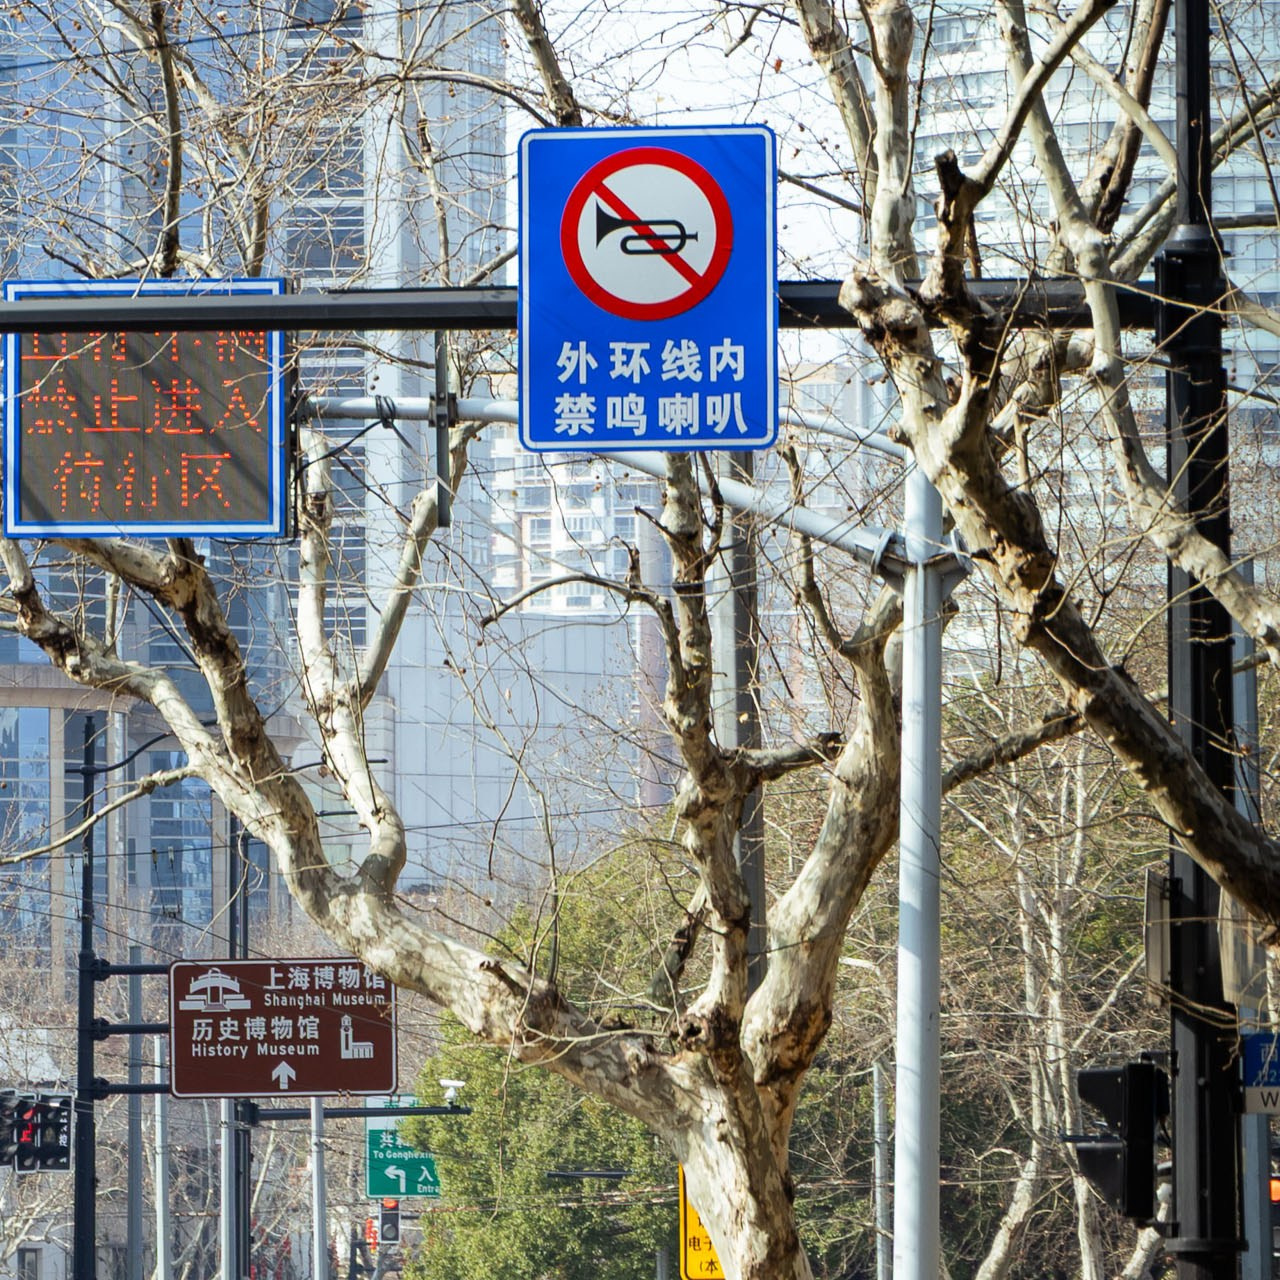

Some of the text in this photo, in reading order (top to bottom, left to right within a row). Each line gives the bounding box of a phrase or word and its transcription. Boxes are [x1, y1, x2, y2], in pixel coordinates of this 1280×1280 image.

[556, 338, 745, 385] 外环线内
[554, 392, 748, 436] 禁鸣喇叭
[263, 965, 386, 990] 上海博物馆
[264, 992, 386, 1010] Shanghai Museum
[192, 1015, 320, 1041] 历史博物馆
[192, 1042, 320, 1059] History Museum
[1261, 1091, 1279, 1108] W
[373, 1150, 384, 1159] To
[418, 1165, 434, 1182] 入
[417, 1184, 440, 1193] Entra
